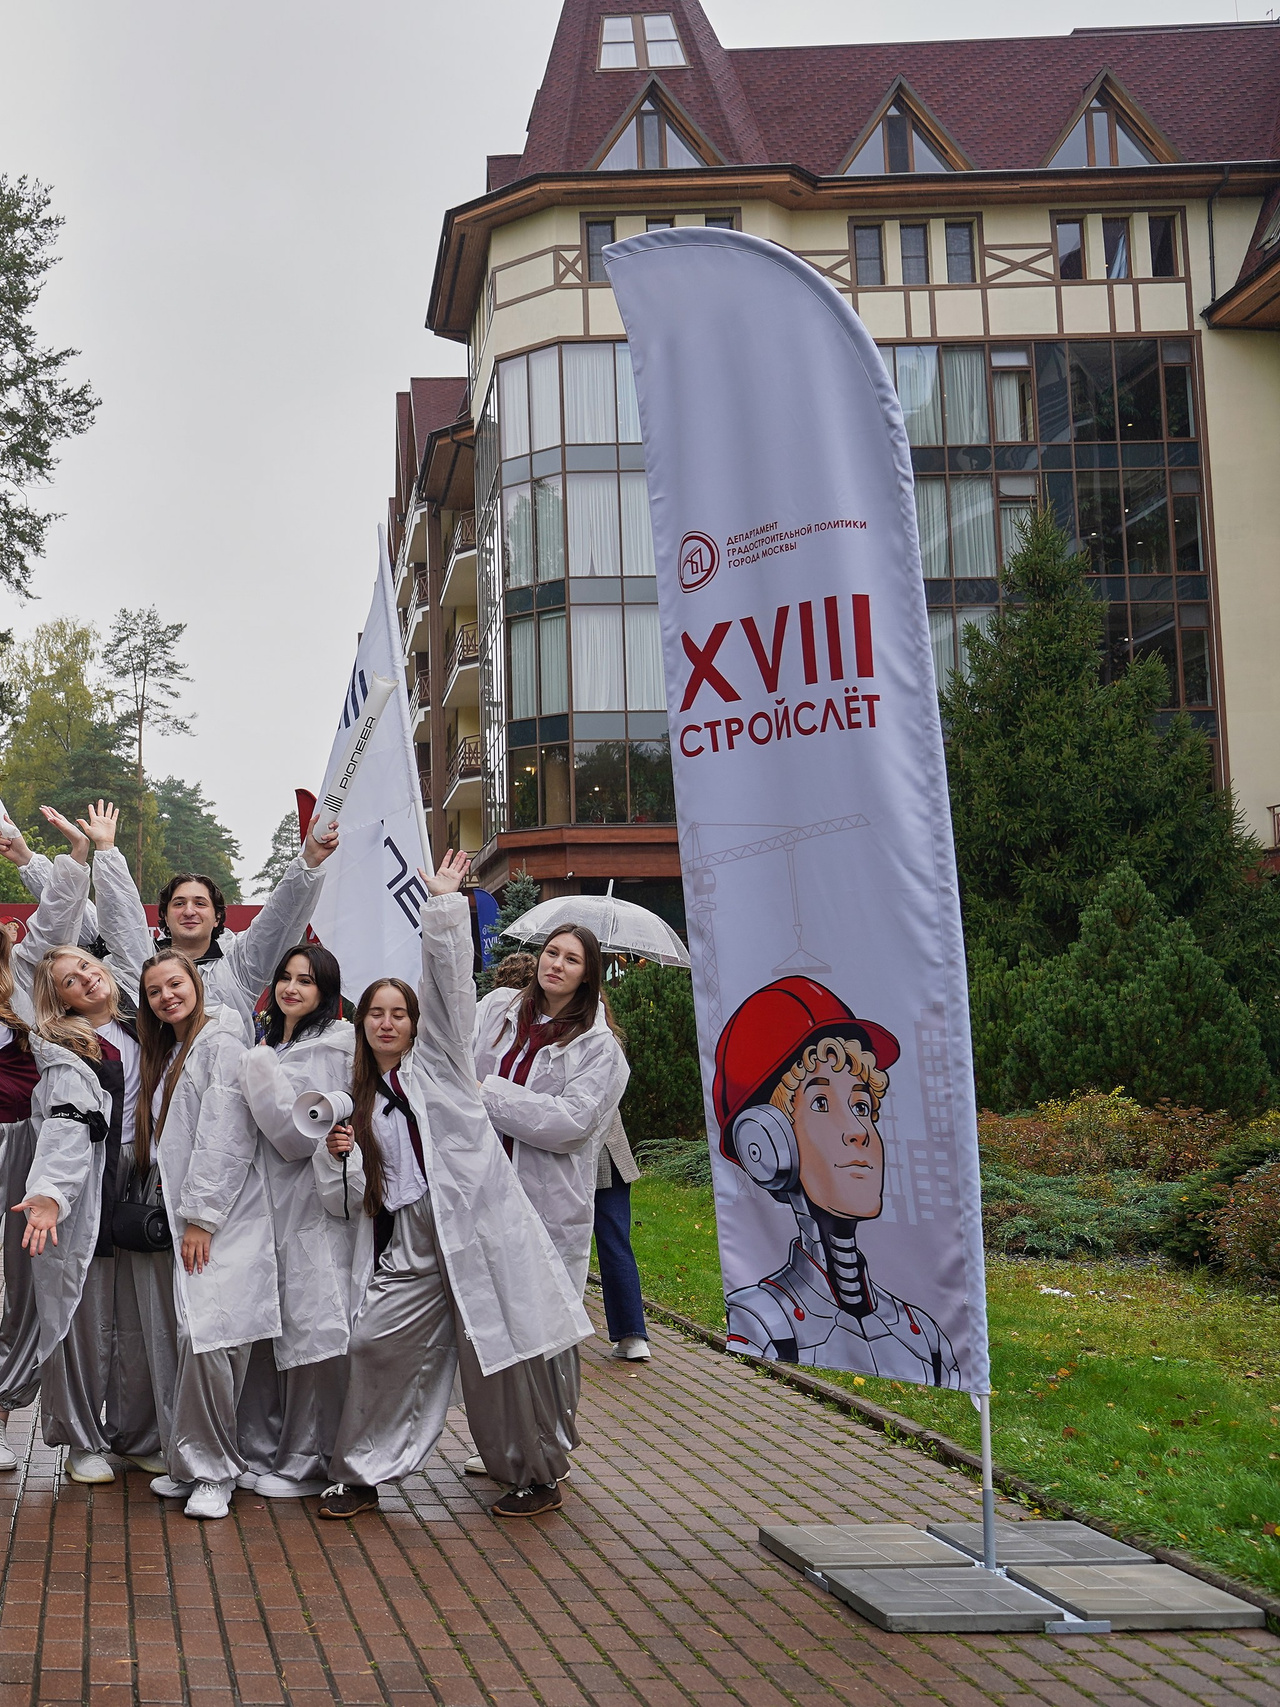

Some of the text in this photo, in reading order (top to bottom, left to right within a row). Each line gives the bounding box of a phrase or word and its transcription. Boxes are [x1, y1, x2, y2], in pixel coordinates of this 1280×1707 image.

[726, 521, 778, 546] ДЕПАРТАМЕНТ
[727, 520, 867, 557] ГРАДОСТРОИТЕЛЬНОЙ ПОЛИТИКИ
[728, 542, 797, 568] ГОРОДА МОСКВЫ
[679, 594, 874, 713] XVIII
[680, 686, 880, 757] СТРОЙСЛЁТ
[339, 716, 376, 790] PIONEER
